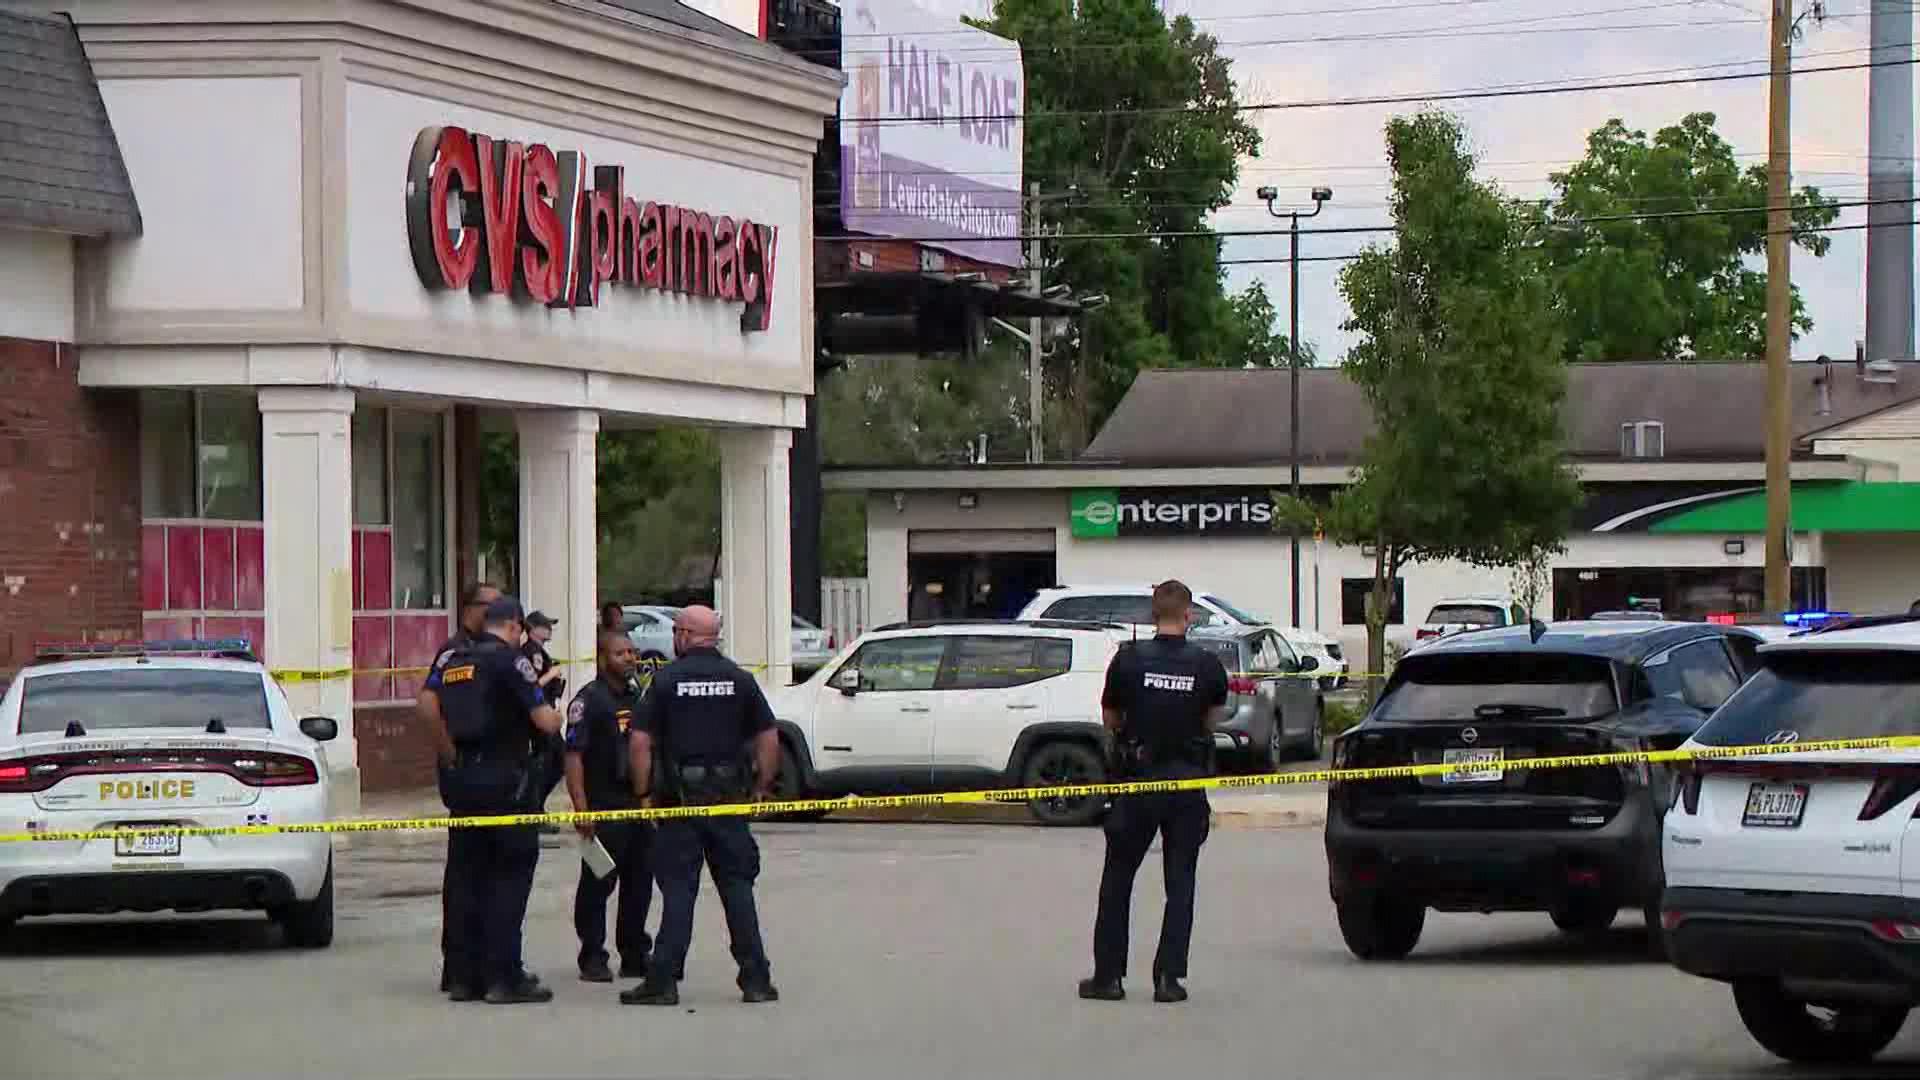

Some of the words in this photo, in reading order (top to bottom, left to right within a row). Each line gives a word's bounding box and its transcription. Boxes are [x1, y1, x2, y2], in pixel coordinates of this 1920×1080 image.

[888, 37, 951, 127] HALF
[959, 64, 1017, 149] LOAF
[888, 173, 1017, 237] LewisBakeShop.com
[1085, 496, 1276, 529] enterpris
[677, 686, 736, 697] POLICE
[1144, 677, 1194, 691] POLICE
[99, 780, 195, 801] POLICE
